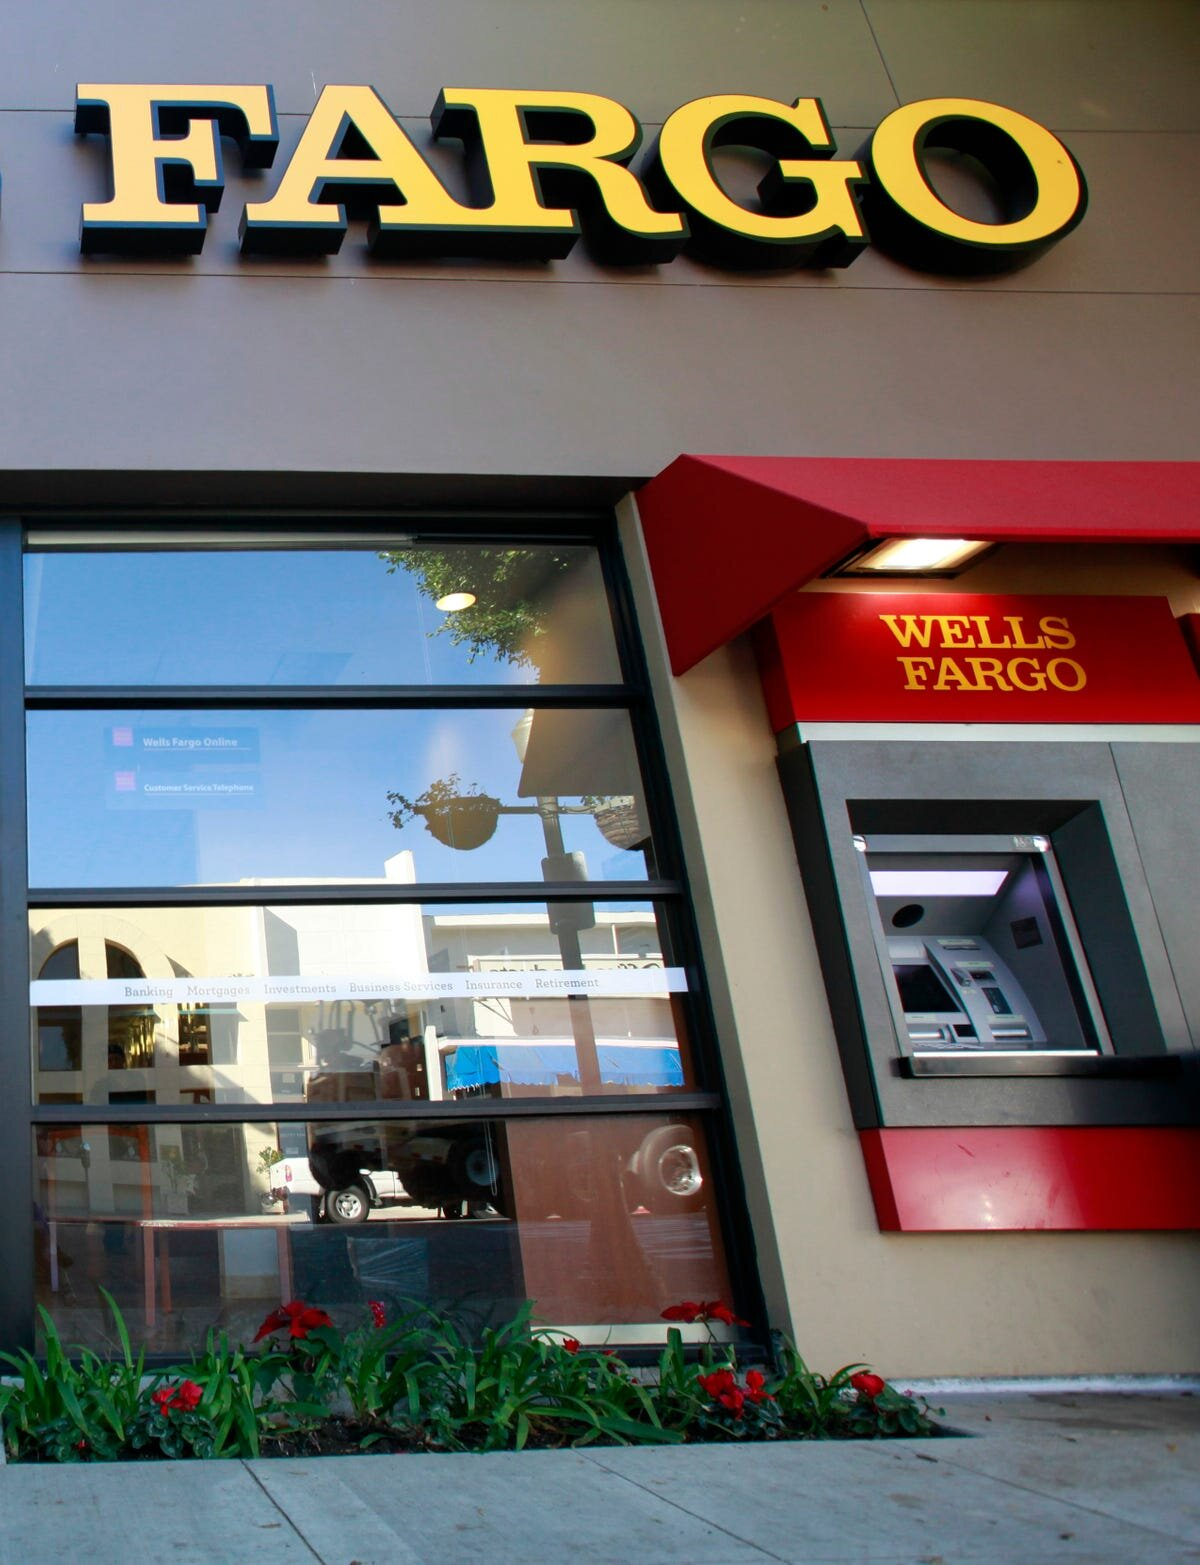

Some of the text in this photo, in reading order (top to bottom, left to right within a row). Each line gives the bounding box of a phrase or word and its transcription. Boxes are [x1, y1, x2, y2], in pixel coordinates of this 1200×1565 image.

[75, 83, 1082, 246] FARGO
[879, 615, 1076, 649] WELLS
[897, 657, 1087, 691] FARGO
[143, 737, 171, 747] Wells
[173, 737, 201, 748] Fargo
[204, 737, 238, 747] Online
[144, 783, 254, 793] Customer Service Telephone
[124, 977, 599, 998] Banking Mortgages Investments Business Services Insurance Retirement
